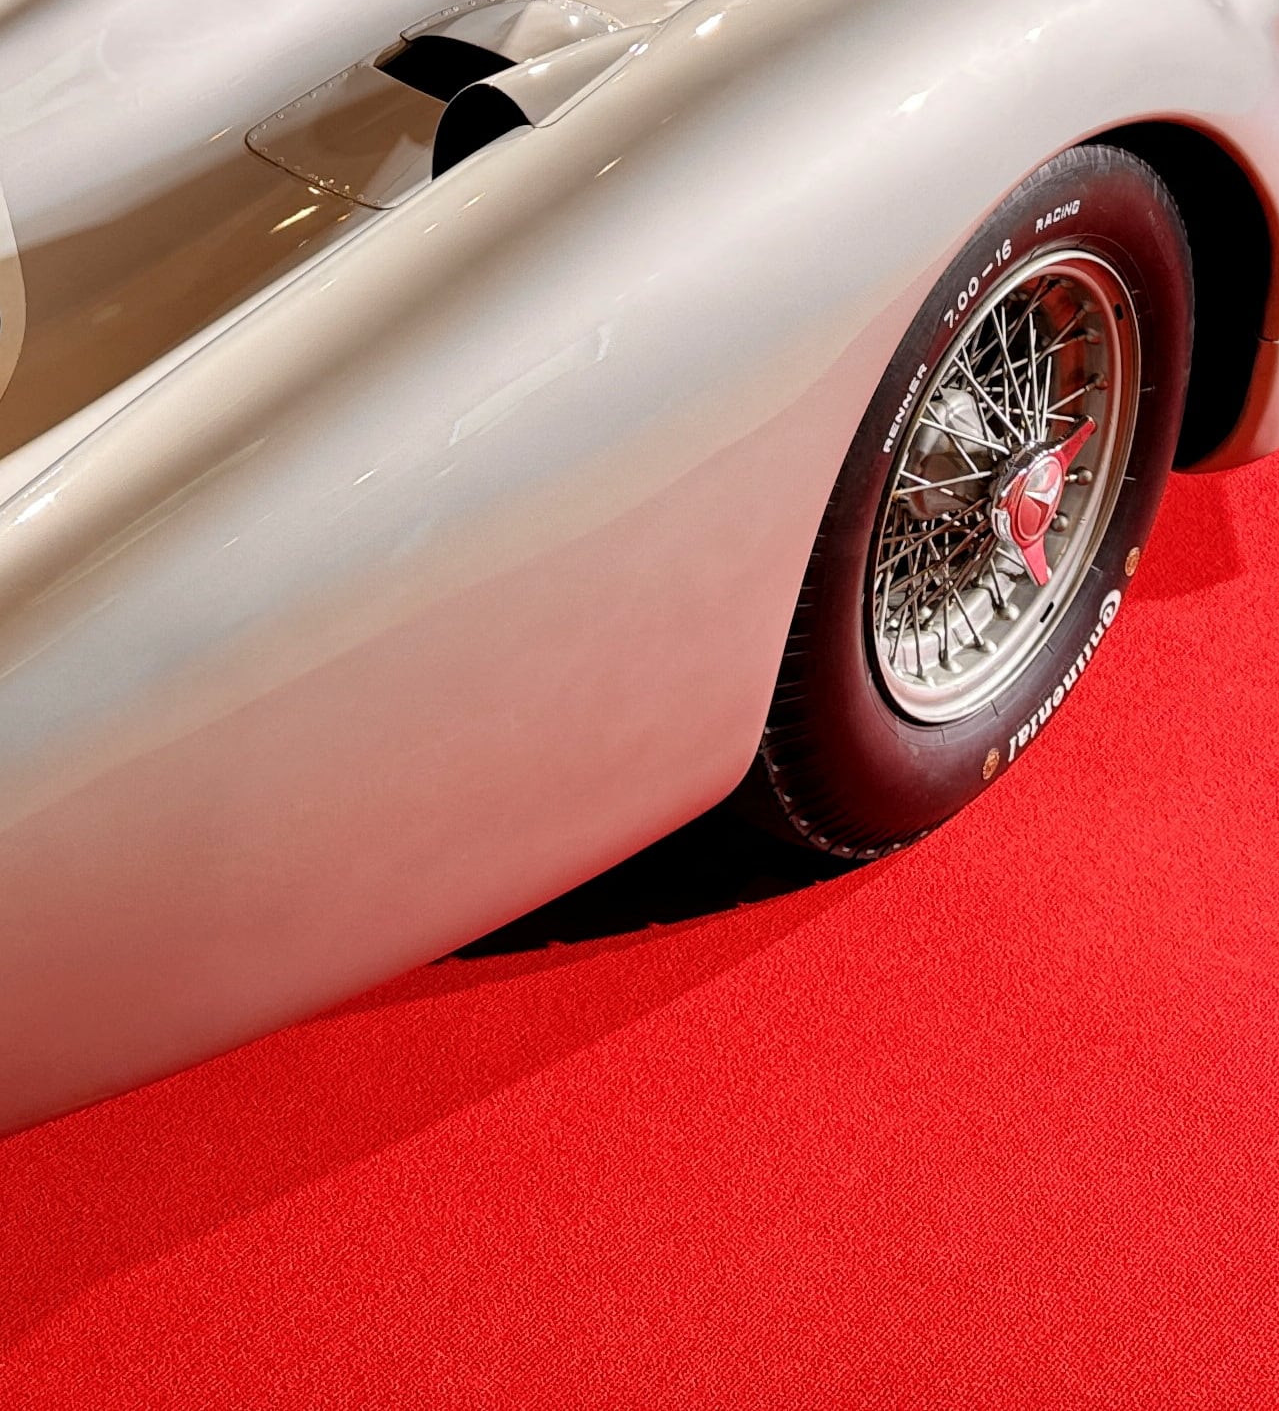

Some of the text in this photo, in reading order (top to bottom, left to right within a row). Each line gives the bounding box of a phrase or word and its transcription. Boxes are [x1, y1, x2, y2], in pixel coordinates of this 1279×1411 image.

[883, 362, 929, 453] RENNER
[1035, 199, 1081, 234] RACING
[1008, 589, 1122, 762] Continental
